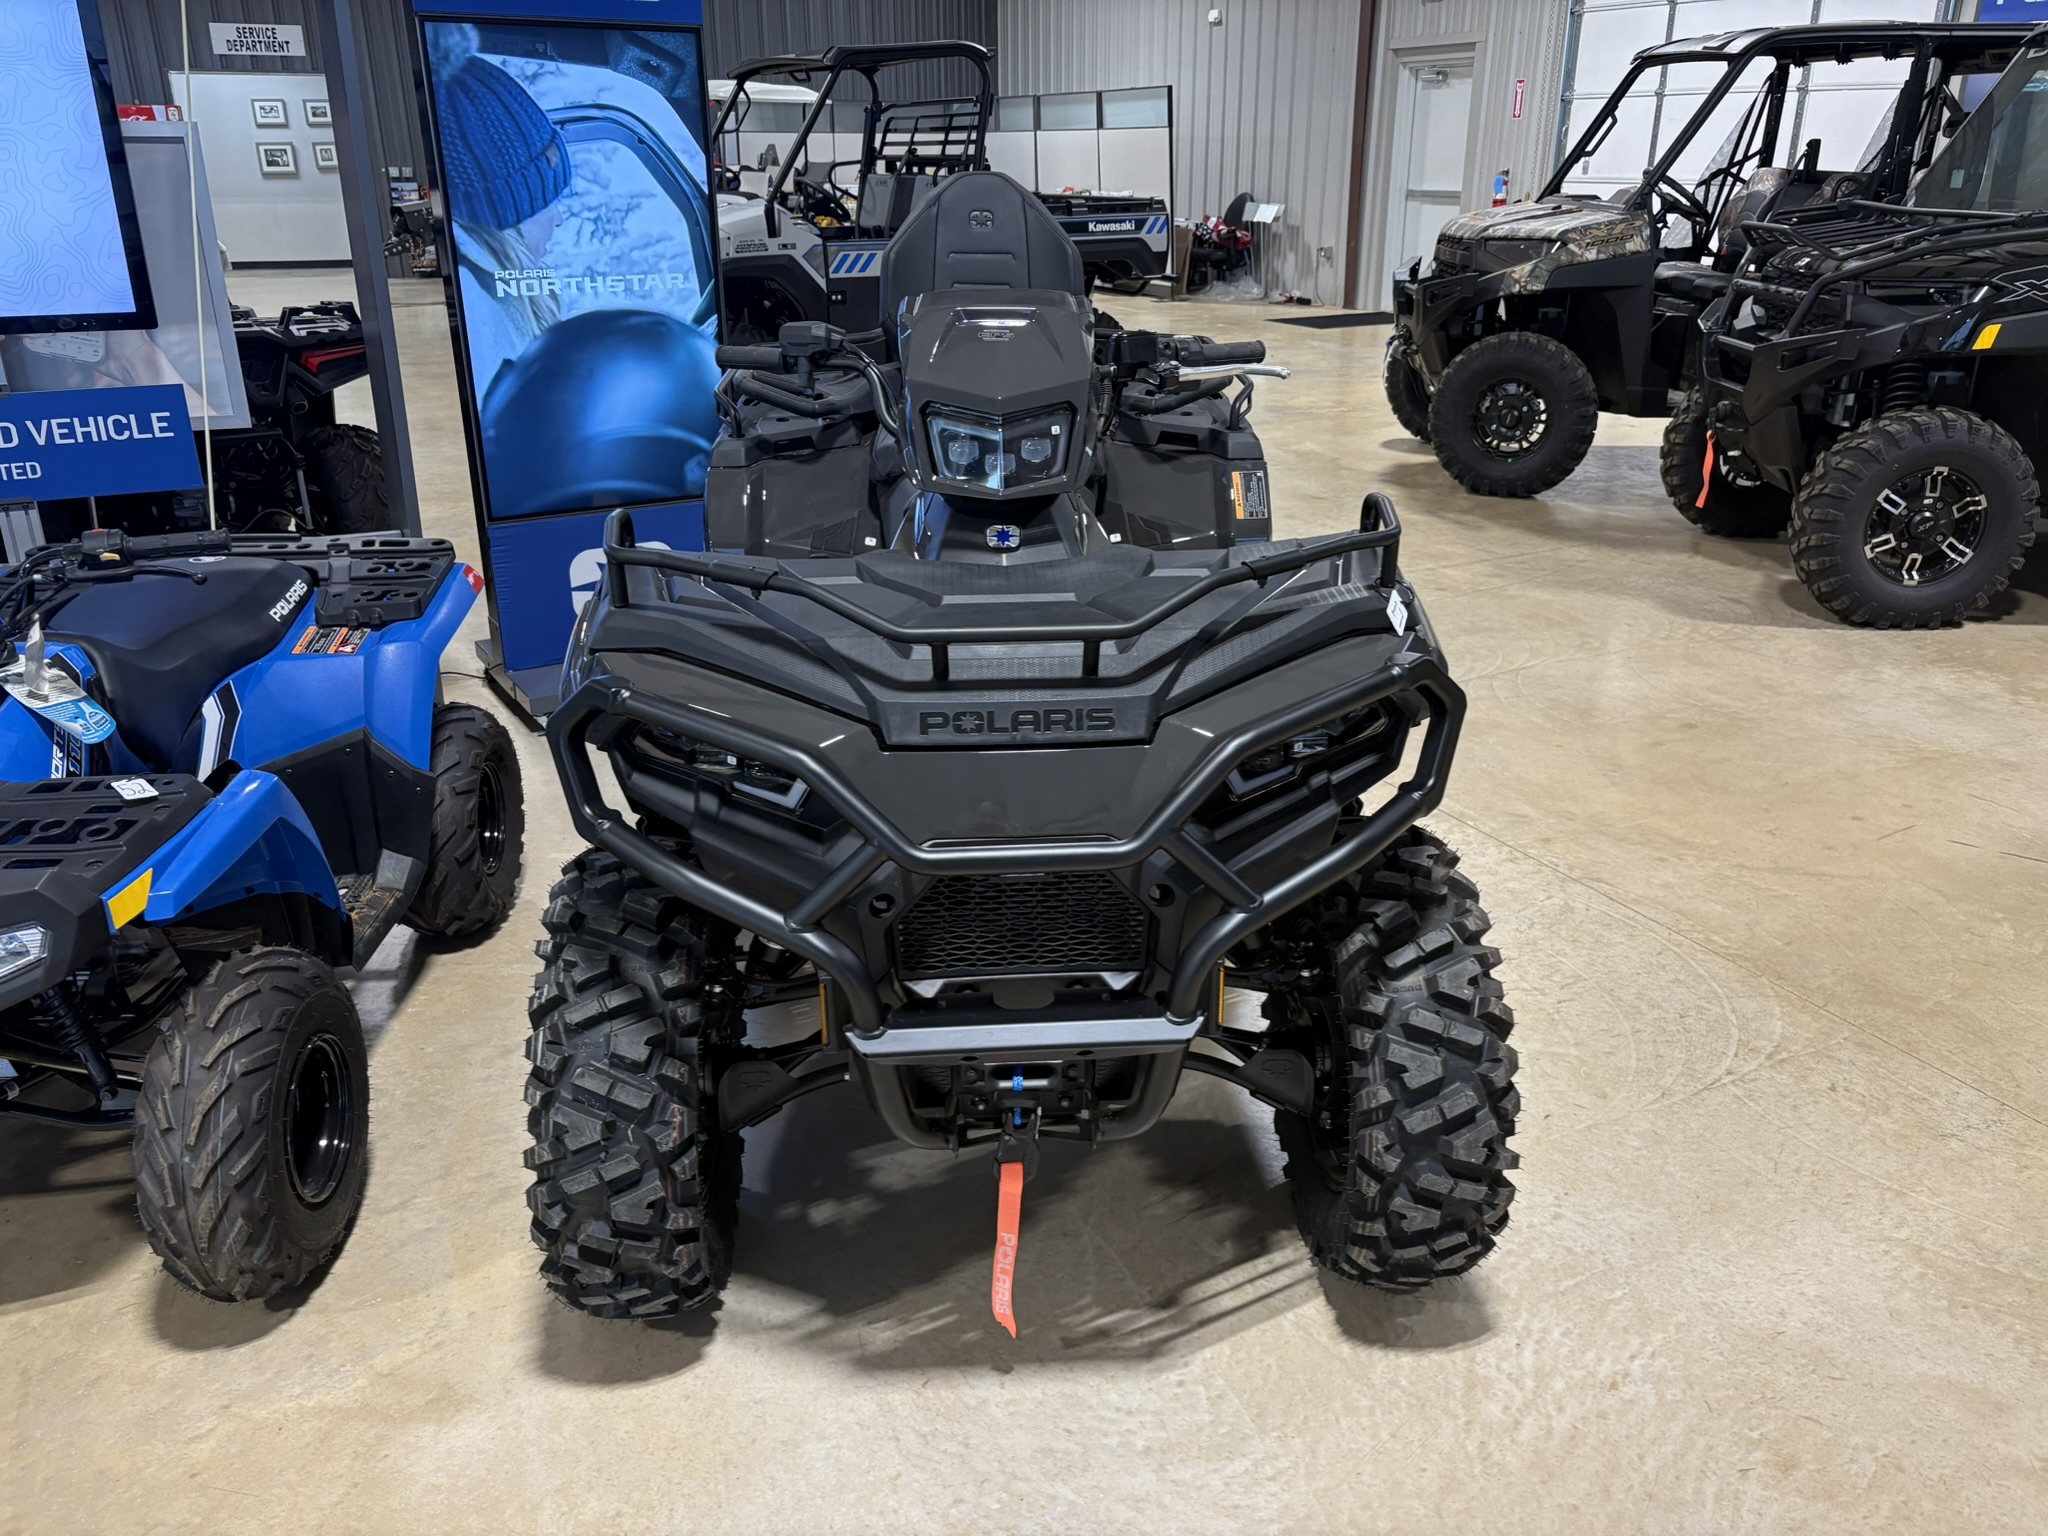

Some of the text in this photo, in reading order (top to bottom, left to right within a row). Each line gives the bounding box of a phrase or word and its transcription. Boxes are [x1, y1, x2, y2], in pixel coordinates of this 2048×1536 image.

[235, 26, 278, 40] SERVICE
[225, 39, 291, 53] DEPARTMENT
[1088, 220, 1136, 232] Kawasaki
[1583, 220, 1644, 240] XP
[1585, 234, 1635, 248] 1000
[494, 268, 557, 280] POLARIS
[495, 273, 686, 298] NORTHSTAR
[25, 411, 175, 446] VEHICLE
[268, 579, 308, 622] POLARIS
[919, 707, 1116, 737] POLARIS
[116, 782, 154, 797] 52
[995, 1232, 1016, 1316] POLARIS
